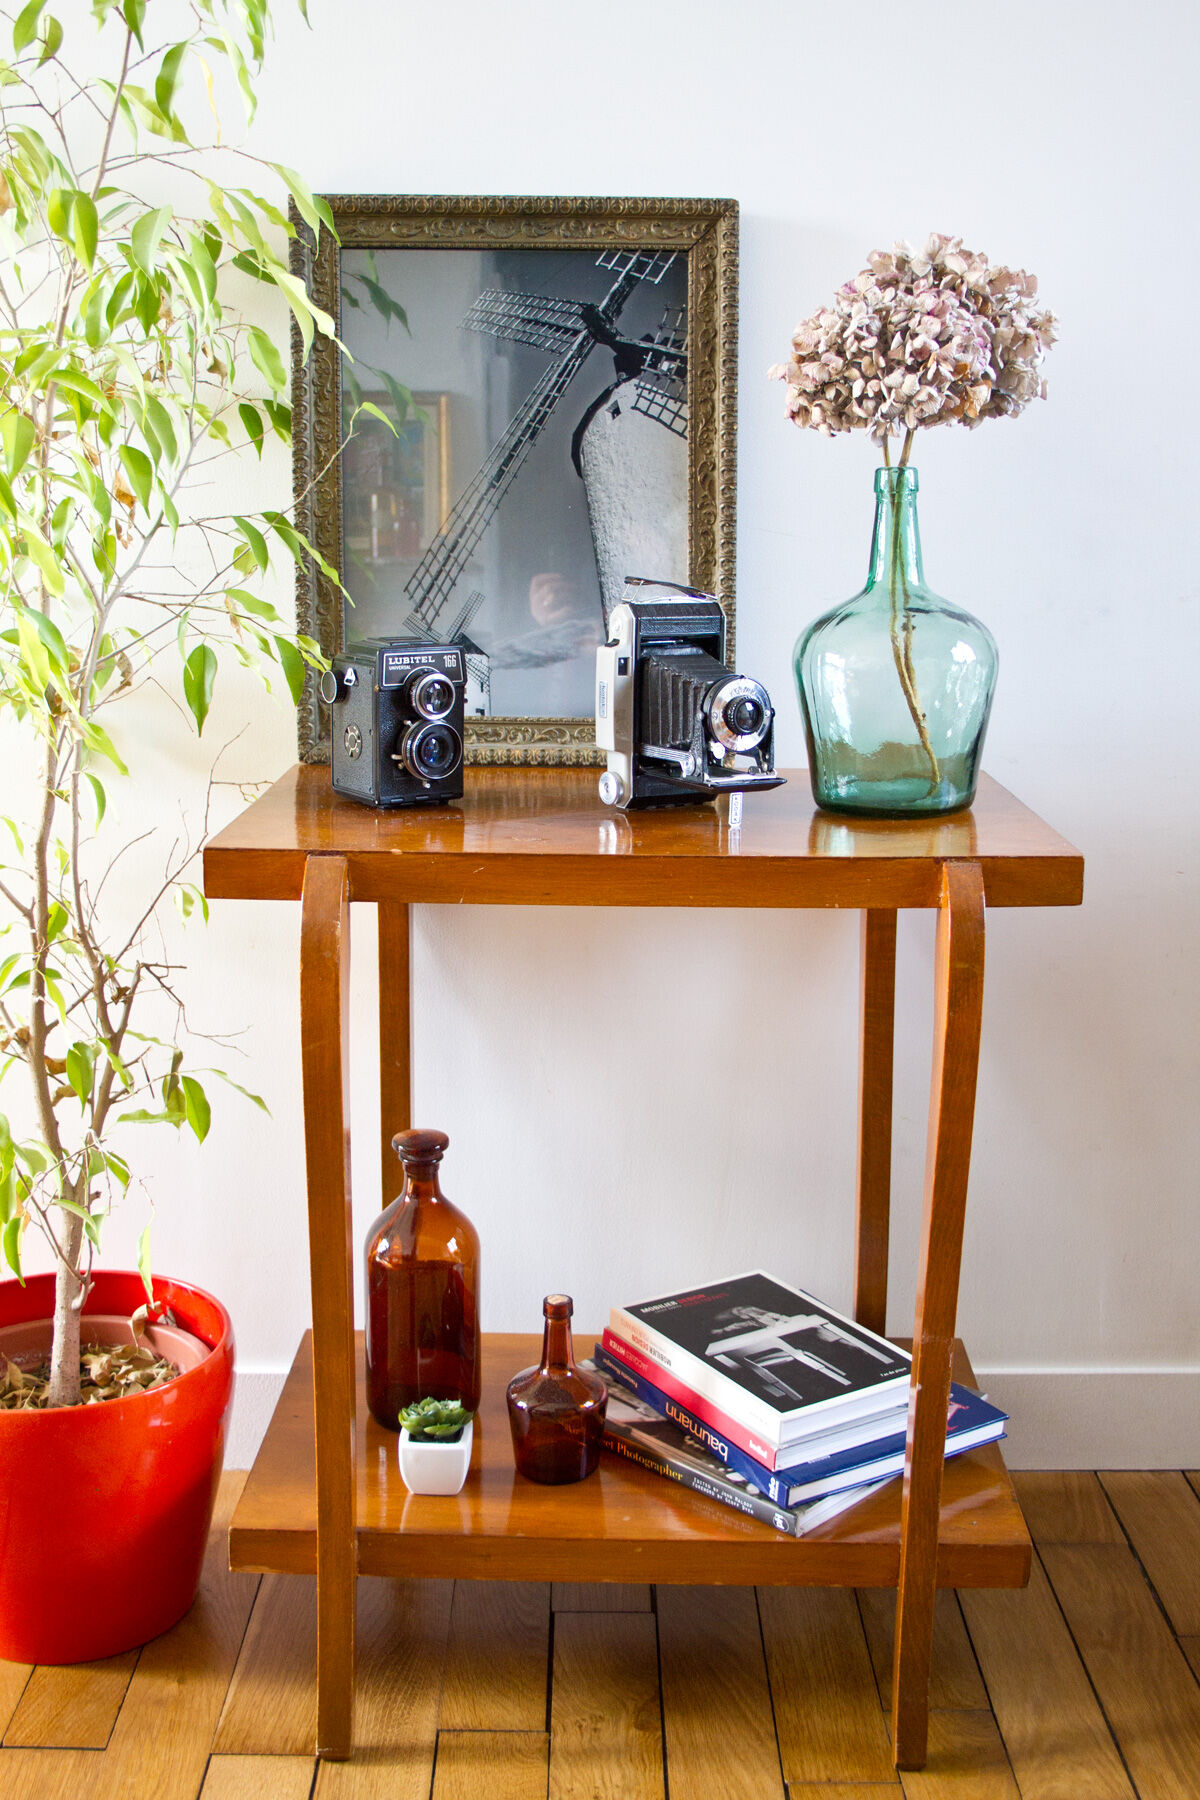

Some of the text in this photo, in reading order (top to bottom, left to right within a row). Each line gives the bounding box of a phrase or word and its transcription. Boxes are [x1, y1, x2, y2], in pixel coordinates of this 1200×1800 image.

[388, 654, 457, 668] LUBITEL 166
[649, 1346, 672, 1367] MOBILIER
[665, 1402, 729, 1462] baumann
[617, 1442, 683, 1481] Photographer
[693, 1477, 711, 1490] EDITED
